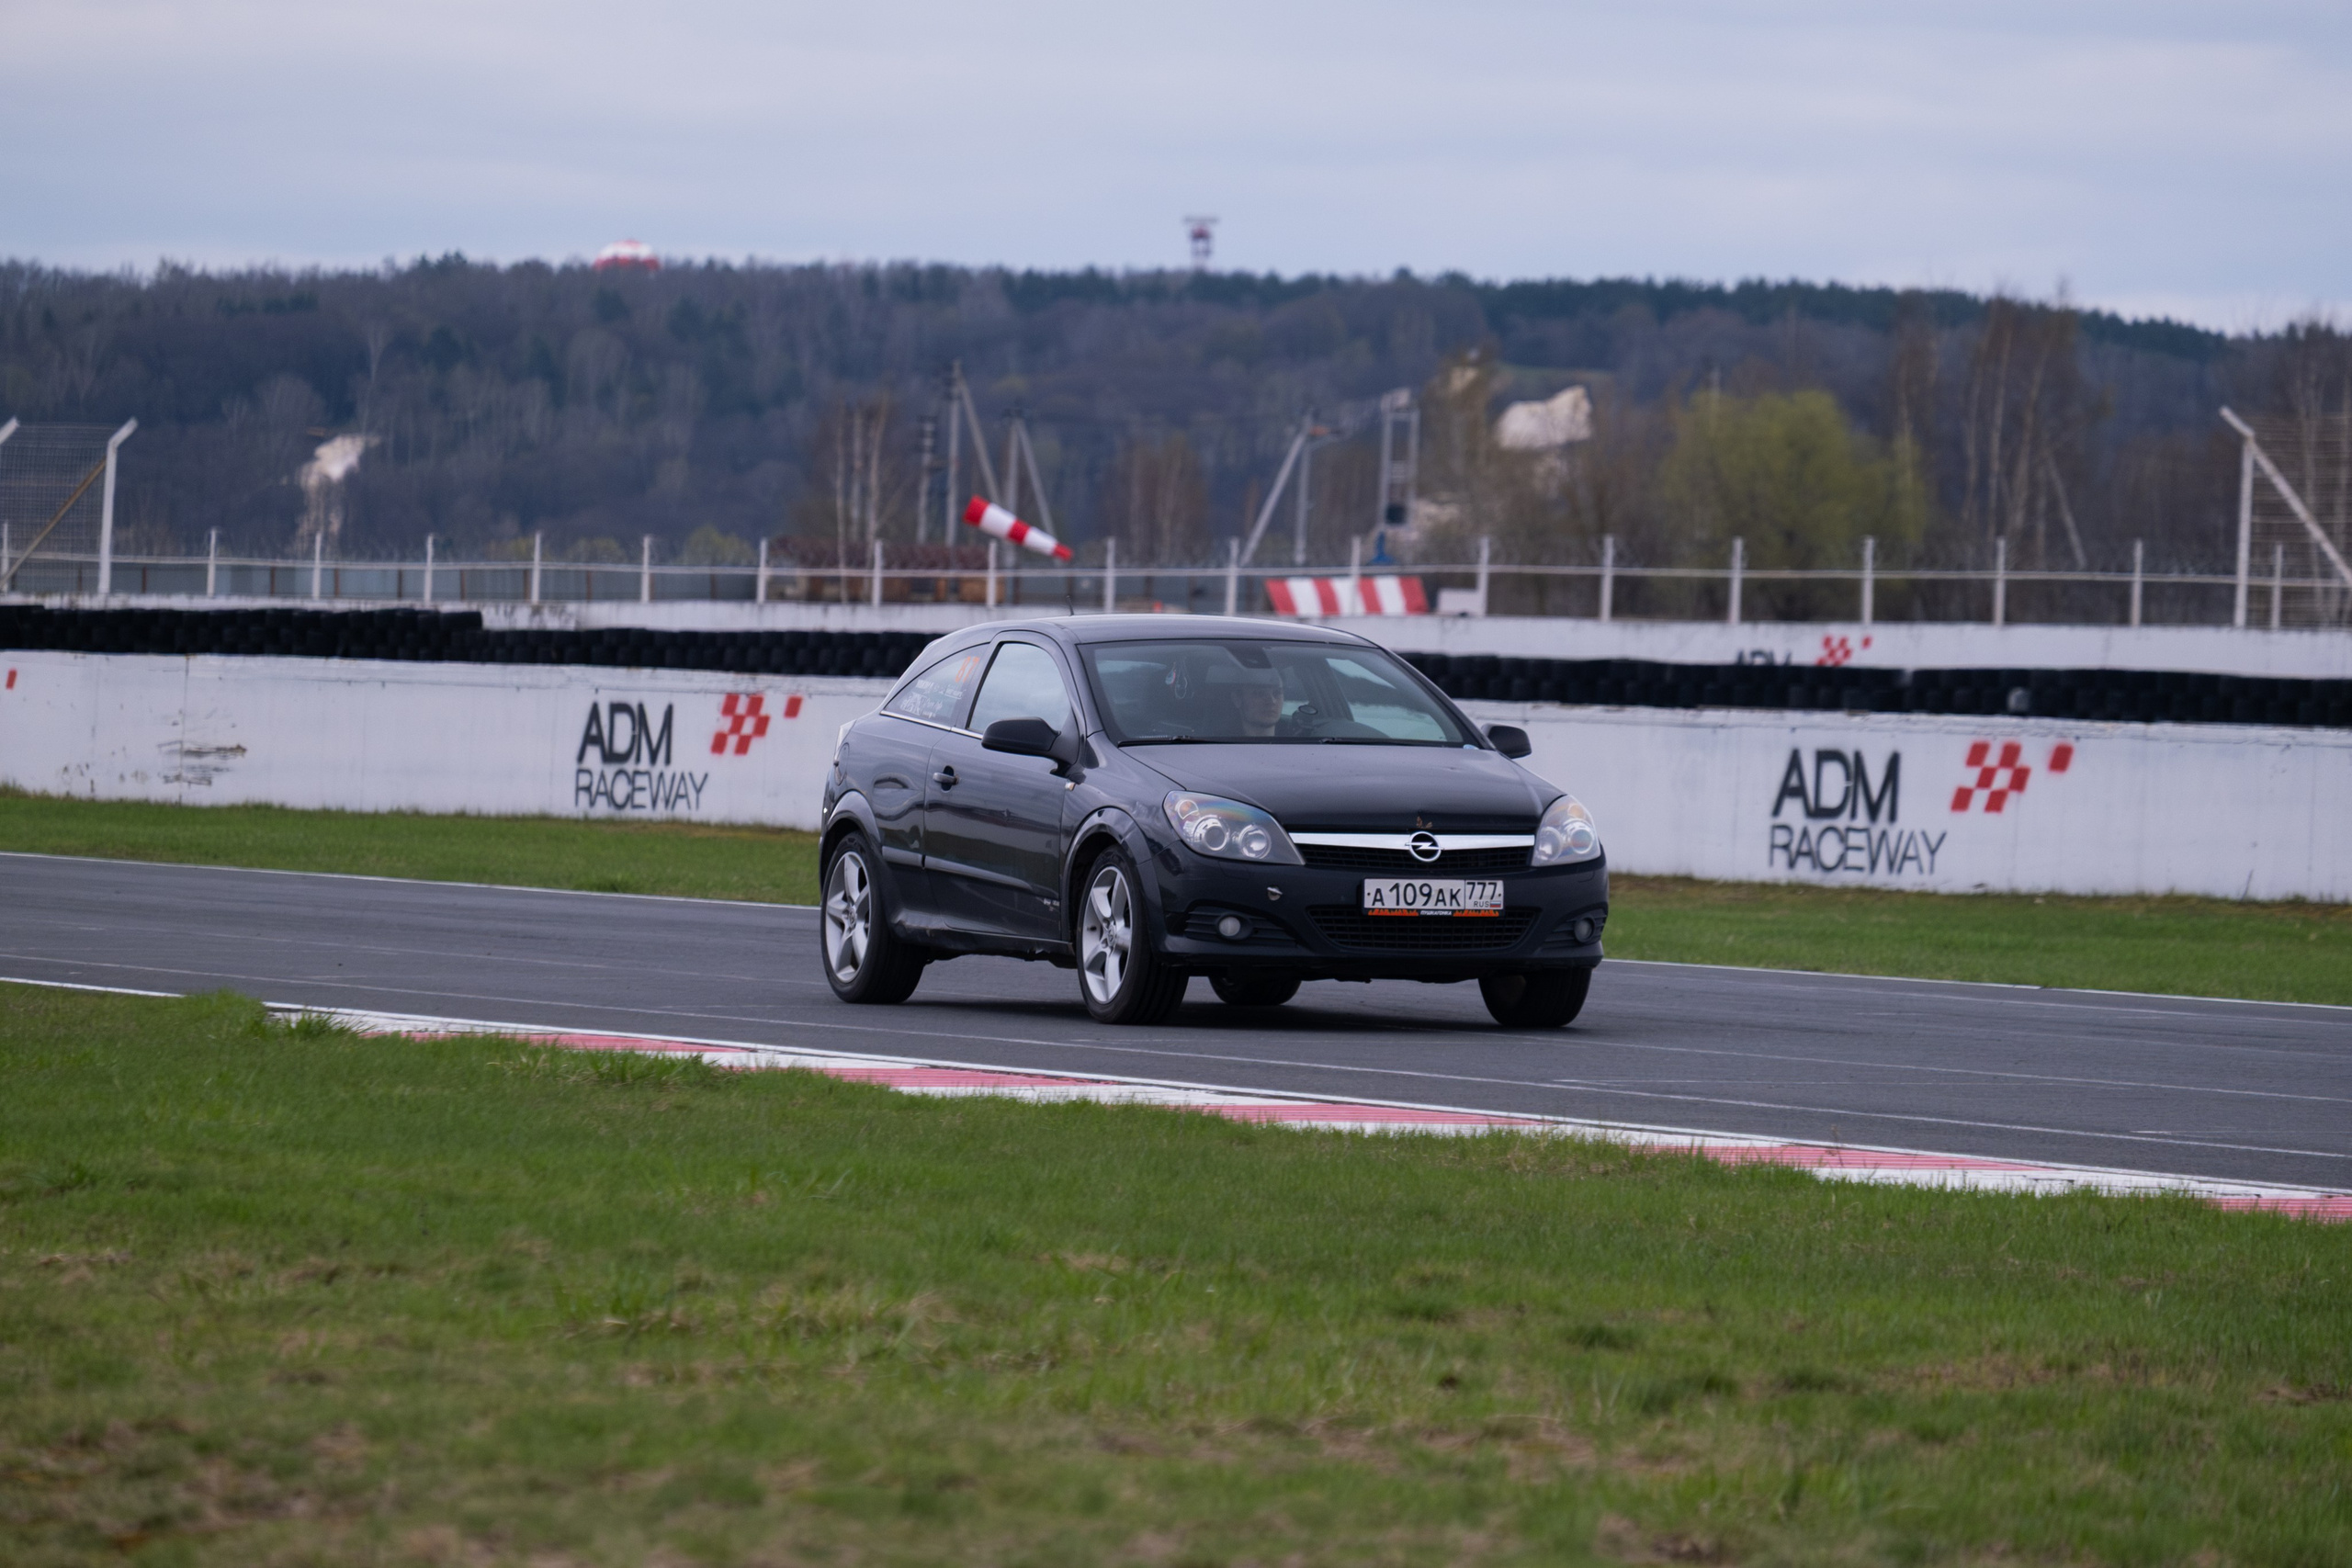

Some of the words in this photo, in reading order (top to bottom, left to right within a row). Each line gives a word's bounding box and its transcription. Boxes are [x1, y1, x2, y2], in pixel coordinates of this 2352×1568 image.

[577, 702, 673, 766] ADM
[575, 768, 708, 811] RACEWAY
[1771, 748, 1900, 823] ADM
[1769, 824, 1946, 874] RACEWAY
[1466, 882, 1498, 900] 777
